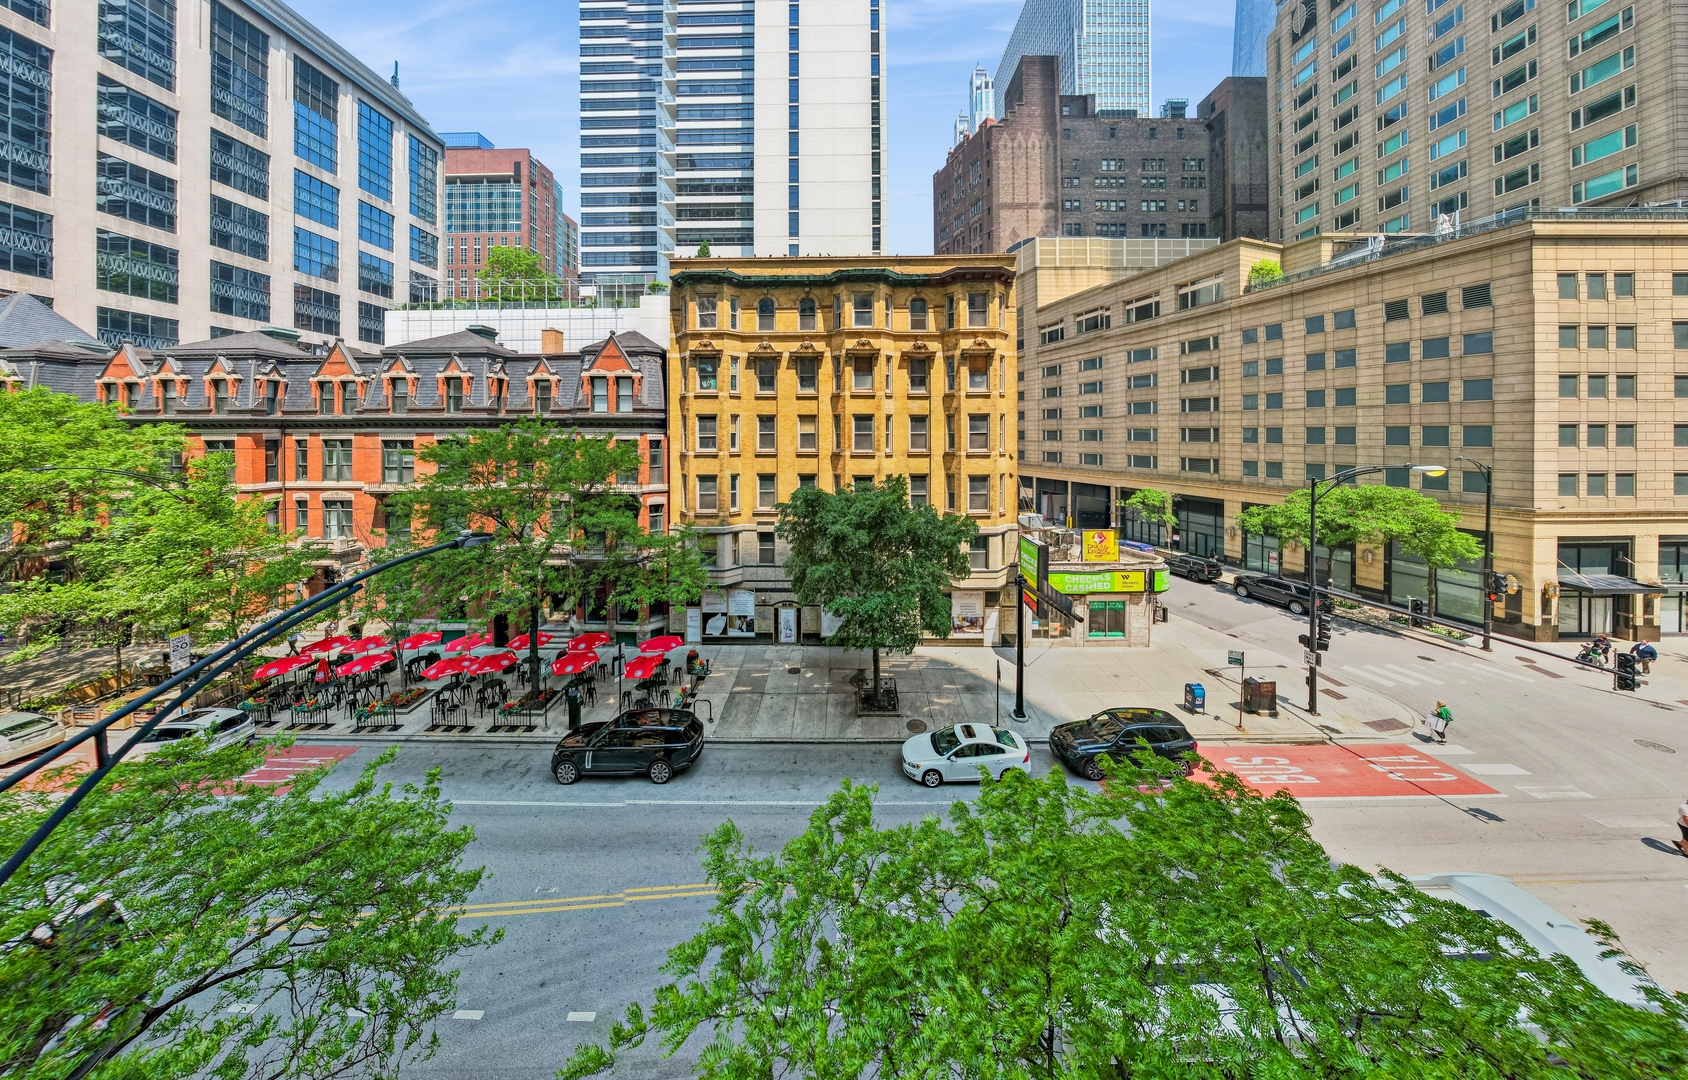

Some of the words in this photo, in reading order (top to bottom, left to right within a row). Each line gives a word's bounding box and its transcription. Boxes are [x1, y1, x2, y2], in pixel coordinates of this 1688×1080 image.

[1065, 573, 1111, 583] CHECKS
[1065, 582, 1111, 592] CASHED
[172, 642, 188, 652] 20
[1225, 756, 1321, 784] BUS
[1359, 755, 1458, 782] CTA
